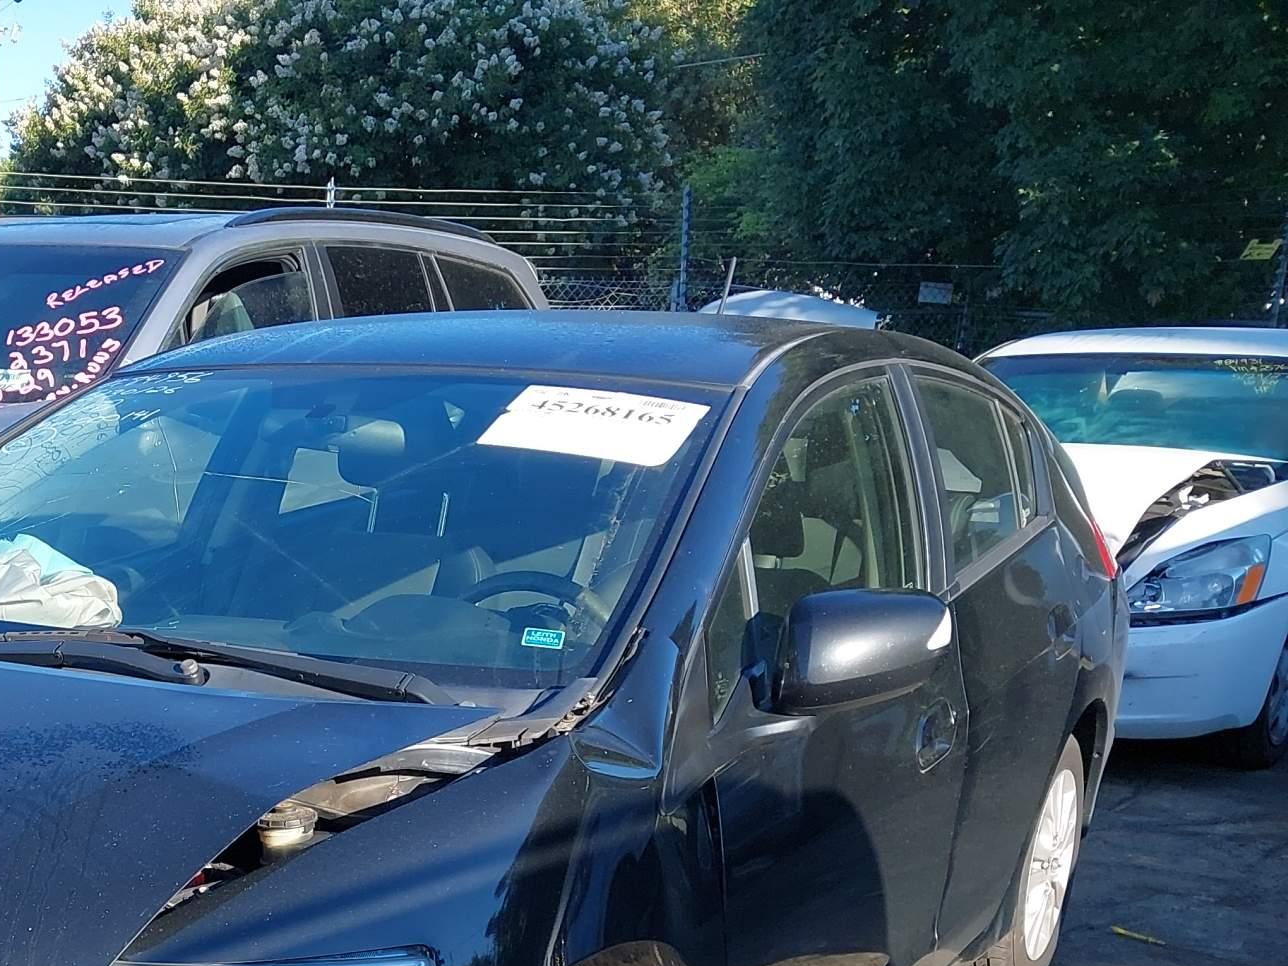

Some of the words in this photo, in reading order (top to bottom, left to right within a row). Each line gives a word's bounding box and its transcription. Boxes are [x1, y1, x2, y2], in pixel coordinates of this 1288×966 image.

[46, 258, 165, 309] RELEASED
[6, 306, 124, 346] 133053
[8, 338, 88, 371] 2371
[531, 399, 676, 425] 45268165
[526, 636, 560, 644] HONDA
